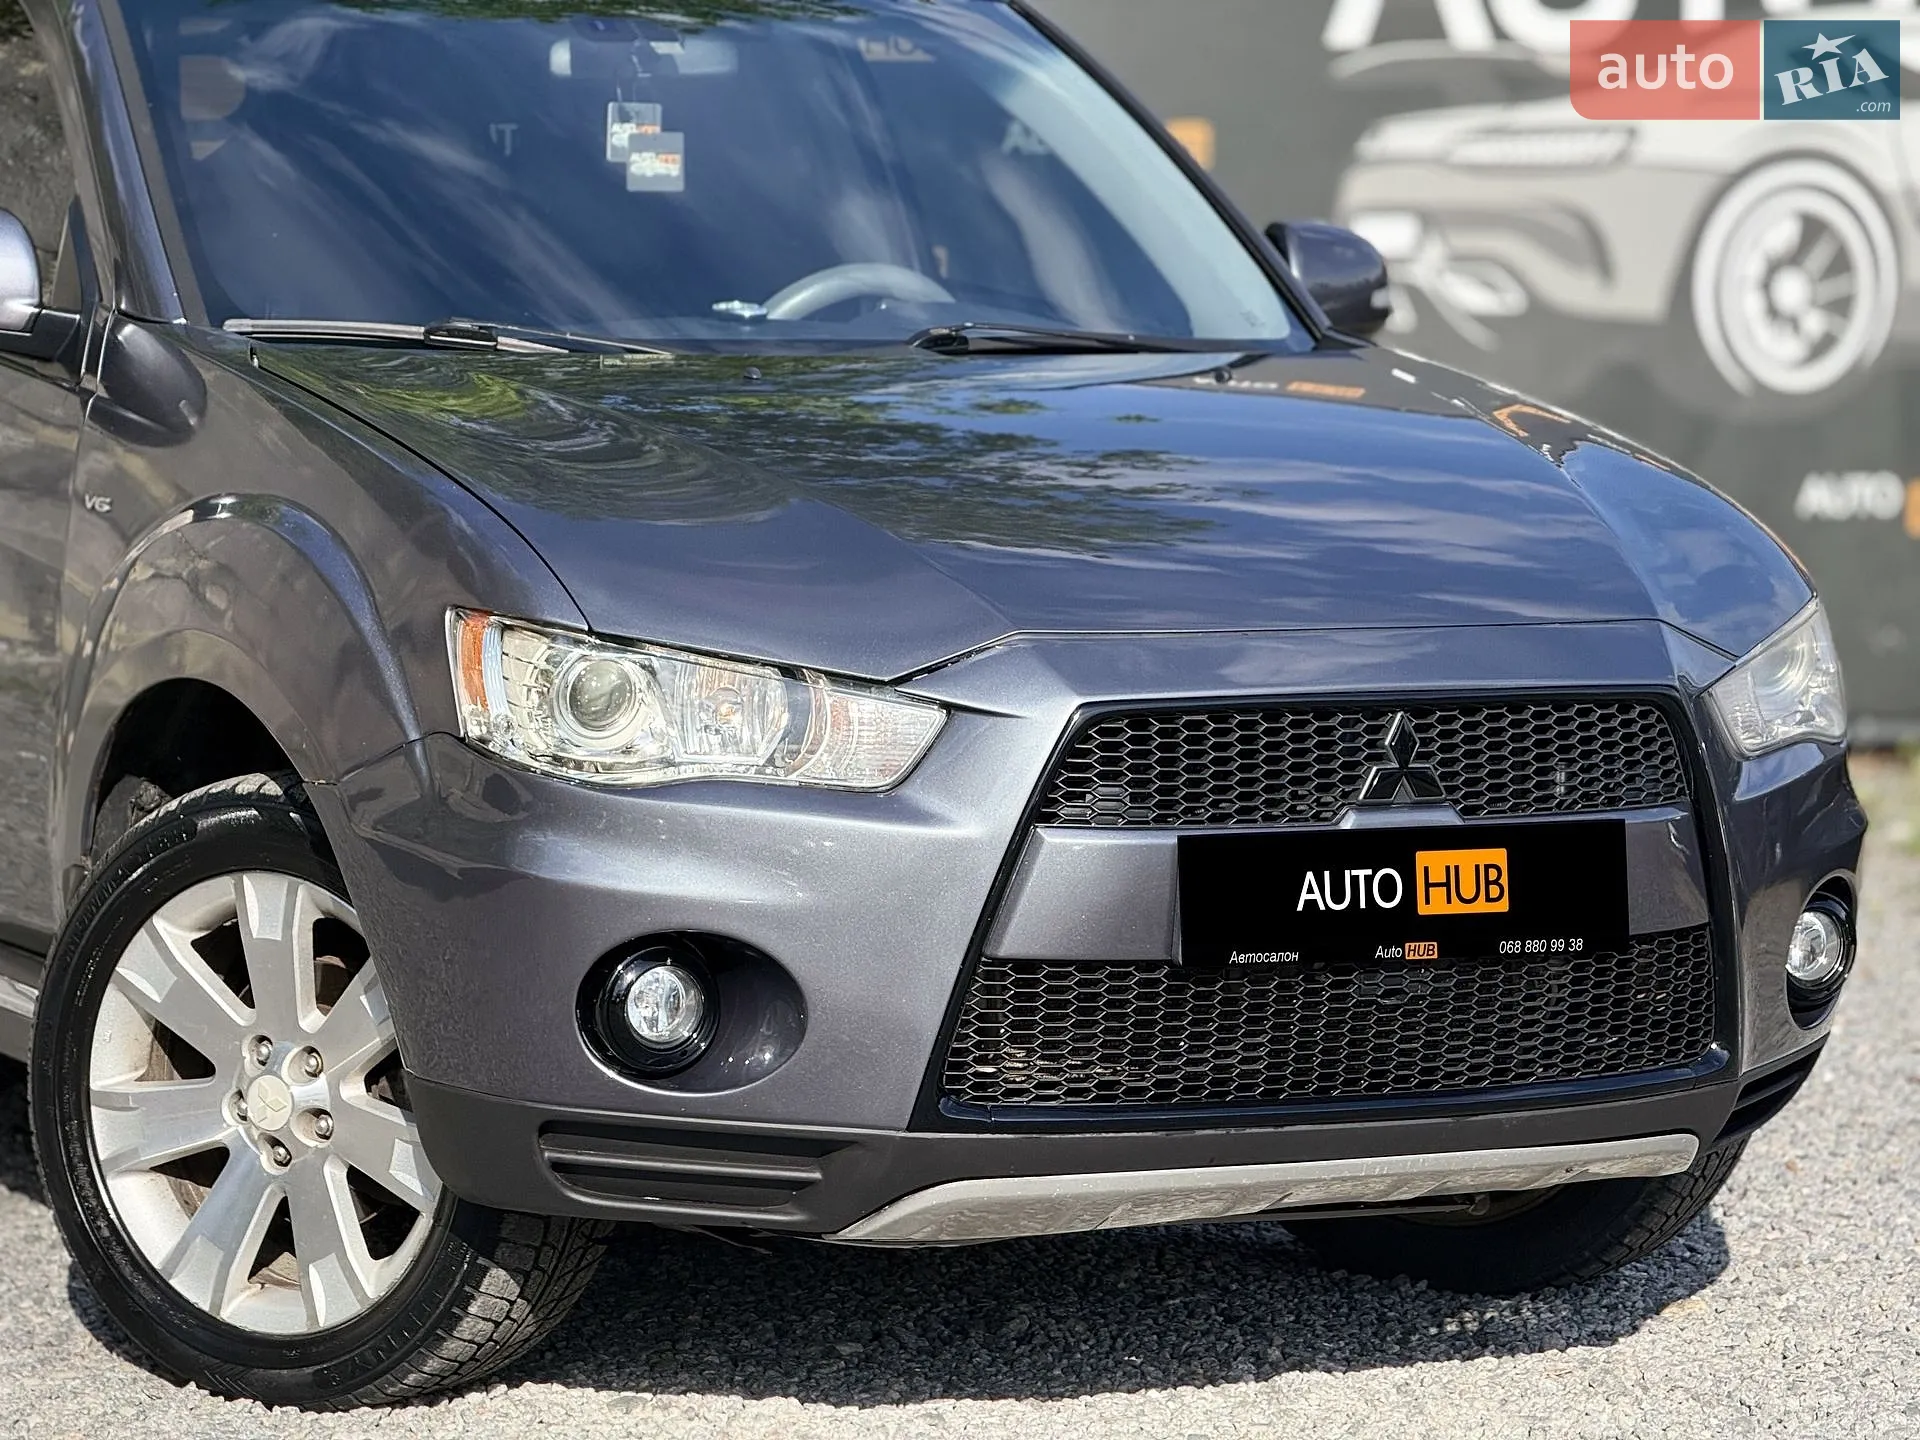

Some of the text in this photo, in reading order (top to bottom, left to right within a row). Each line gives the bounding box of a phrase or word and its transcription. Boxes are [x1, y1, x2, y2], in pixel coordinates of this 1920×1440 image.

[1296, 863, 1505, 911] AUTO HUB
[1374, 943, 1436, 959] Auto HUB
[1499, 937, 1584, 954] 068 880 99 38
[1228, 950, 1299, 965] Автосалон
